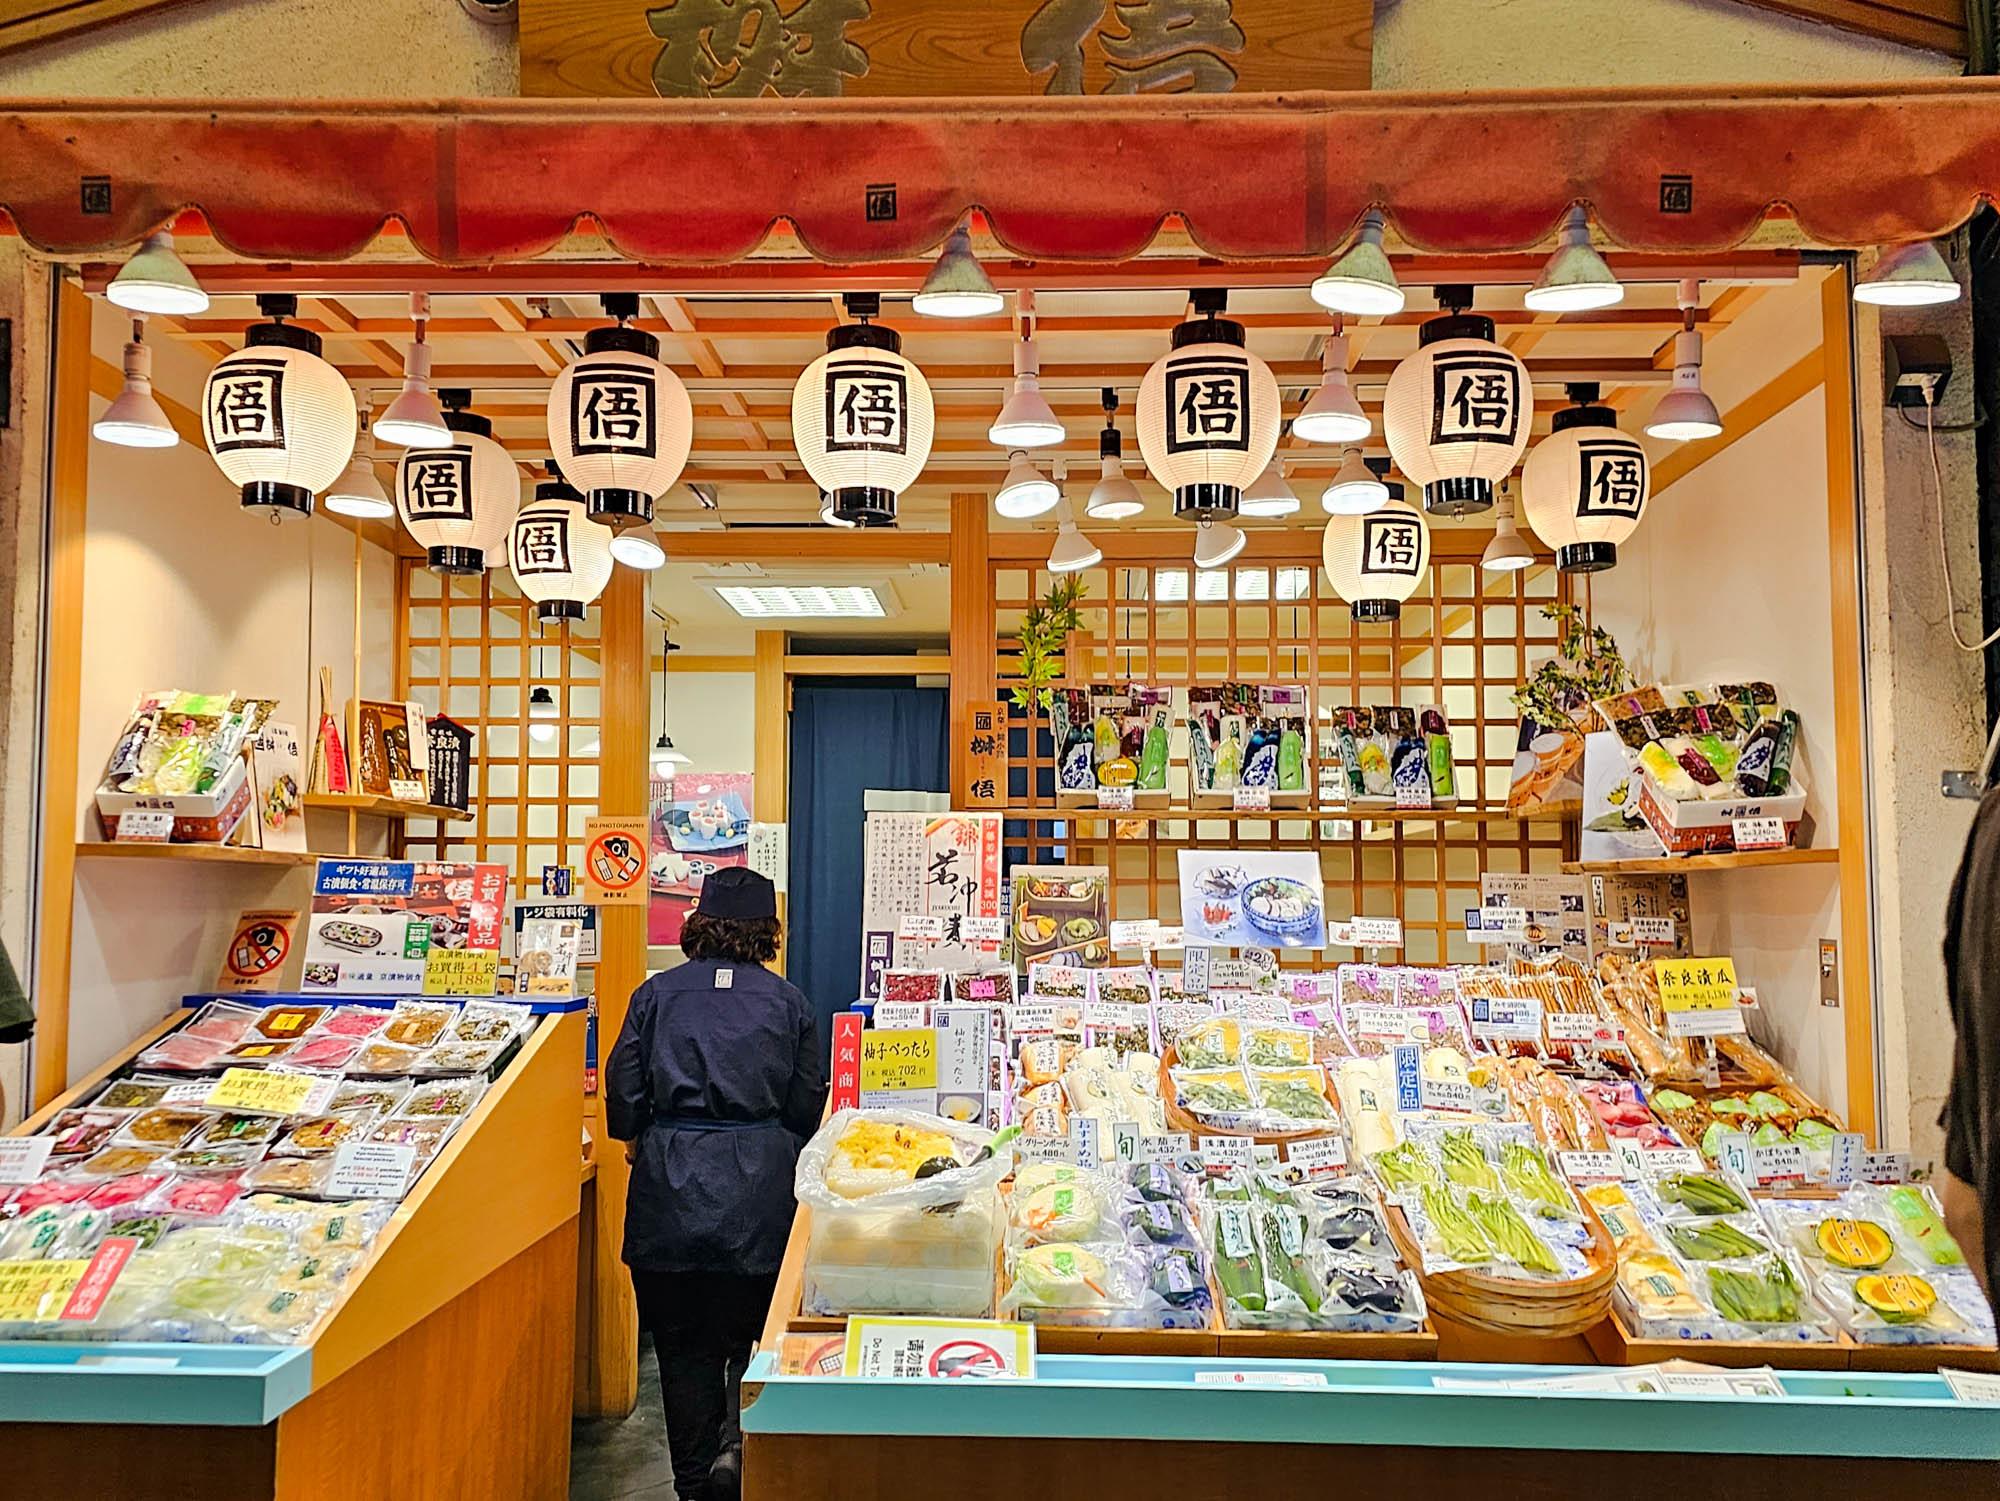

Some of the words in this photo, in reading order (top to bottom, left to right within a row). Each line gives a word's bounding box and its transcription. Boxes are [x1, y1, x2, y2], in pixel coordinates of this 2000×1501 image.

[523, 905, 589, 919] レジ袋有料化
[1210, 962, 1250, 971] ゴーヤレモン
[1661, 967, 1733, 987] 奈良漬瓜
[863, 1040, 931, 1062] 柚子ぺったら
[1399, 1049, 1418, 1109] 限定品
[1024, 1138, 1071, 1148] グリーンボール
[1117, 1131, 1134, 1161] 旬
[1726, 1144, 1746, 1175] 旬
